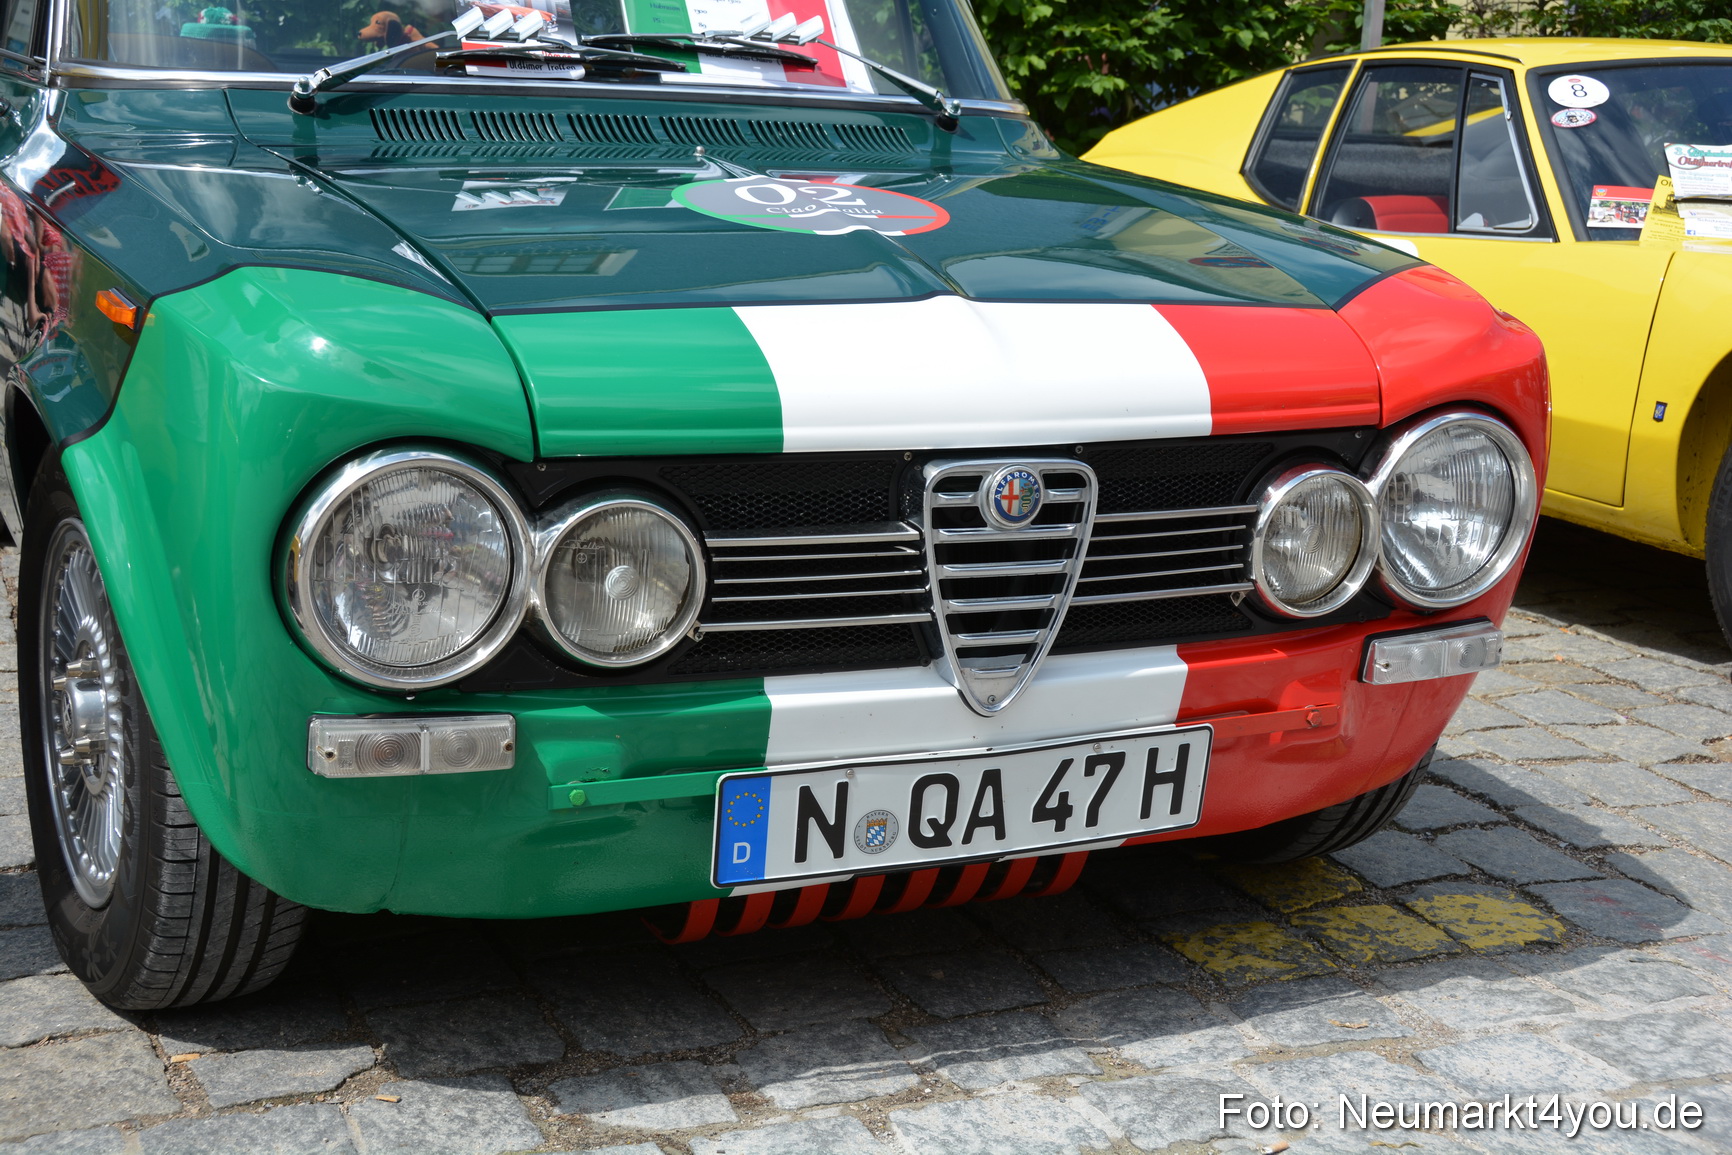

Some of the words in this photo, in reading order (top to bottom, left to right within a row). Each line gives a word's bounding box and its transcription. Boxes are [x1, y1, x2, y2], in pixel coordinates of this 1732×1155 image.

[1571, 83, 1588, 98] 8
[734, 183, 867, 206] 02
[766, 204, 817, 214] Ciao
[826, 203, 884, 215] Ialia
[794, 781, 848, 864] N
[907, 768, 1007, 850] QA
[732, 841, 751, 864] D
